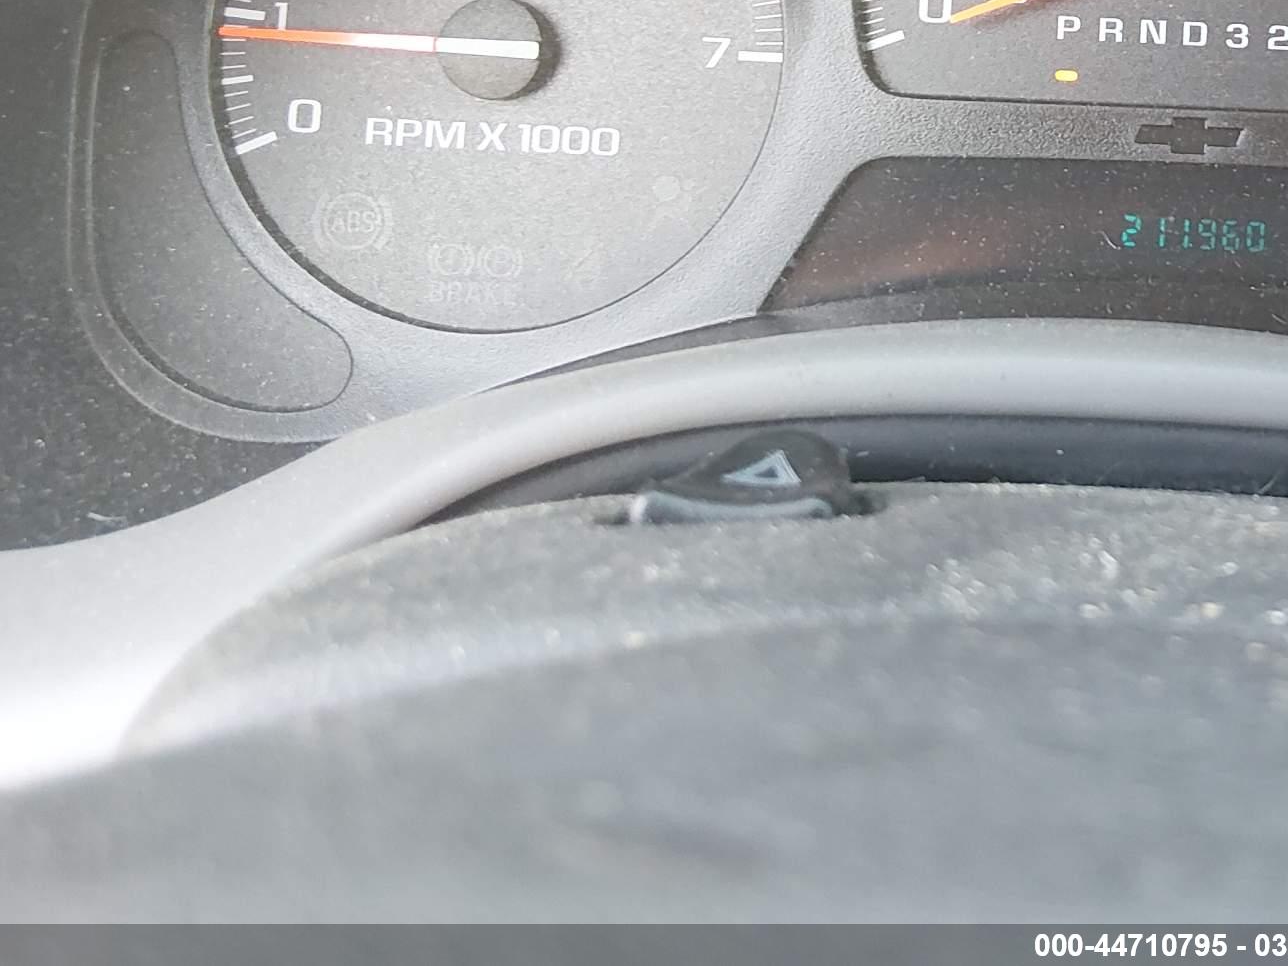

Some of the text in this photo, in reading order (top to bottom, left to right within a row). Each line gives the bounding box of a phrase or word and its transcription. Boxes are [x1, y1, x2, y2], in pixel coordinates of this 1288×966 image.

[275, 2, 288, 30] 1
[1057, 16, 1080, 39] P
[1099, 18, 1123, 42] R
[1140, 20, 1166, 44] N
[1183, 22, 1207, 46] D
[1226, 24, 1248, 48] 3
[702, 37, 730, 67] 7
[288, 99, 321, 133] 0
[366, 118, 619, 155] RPM X 1000
[1121, 214, 1266, 252] 211960
